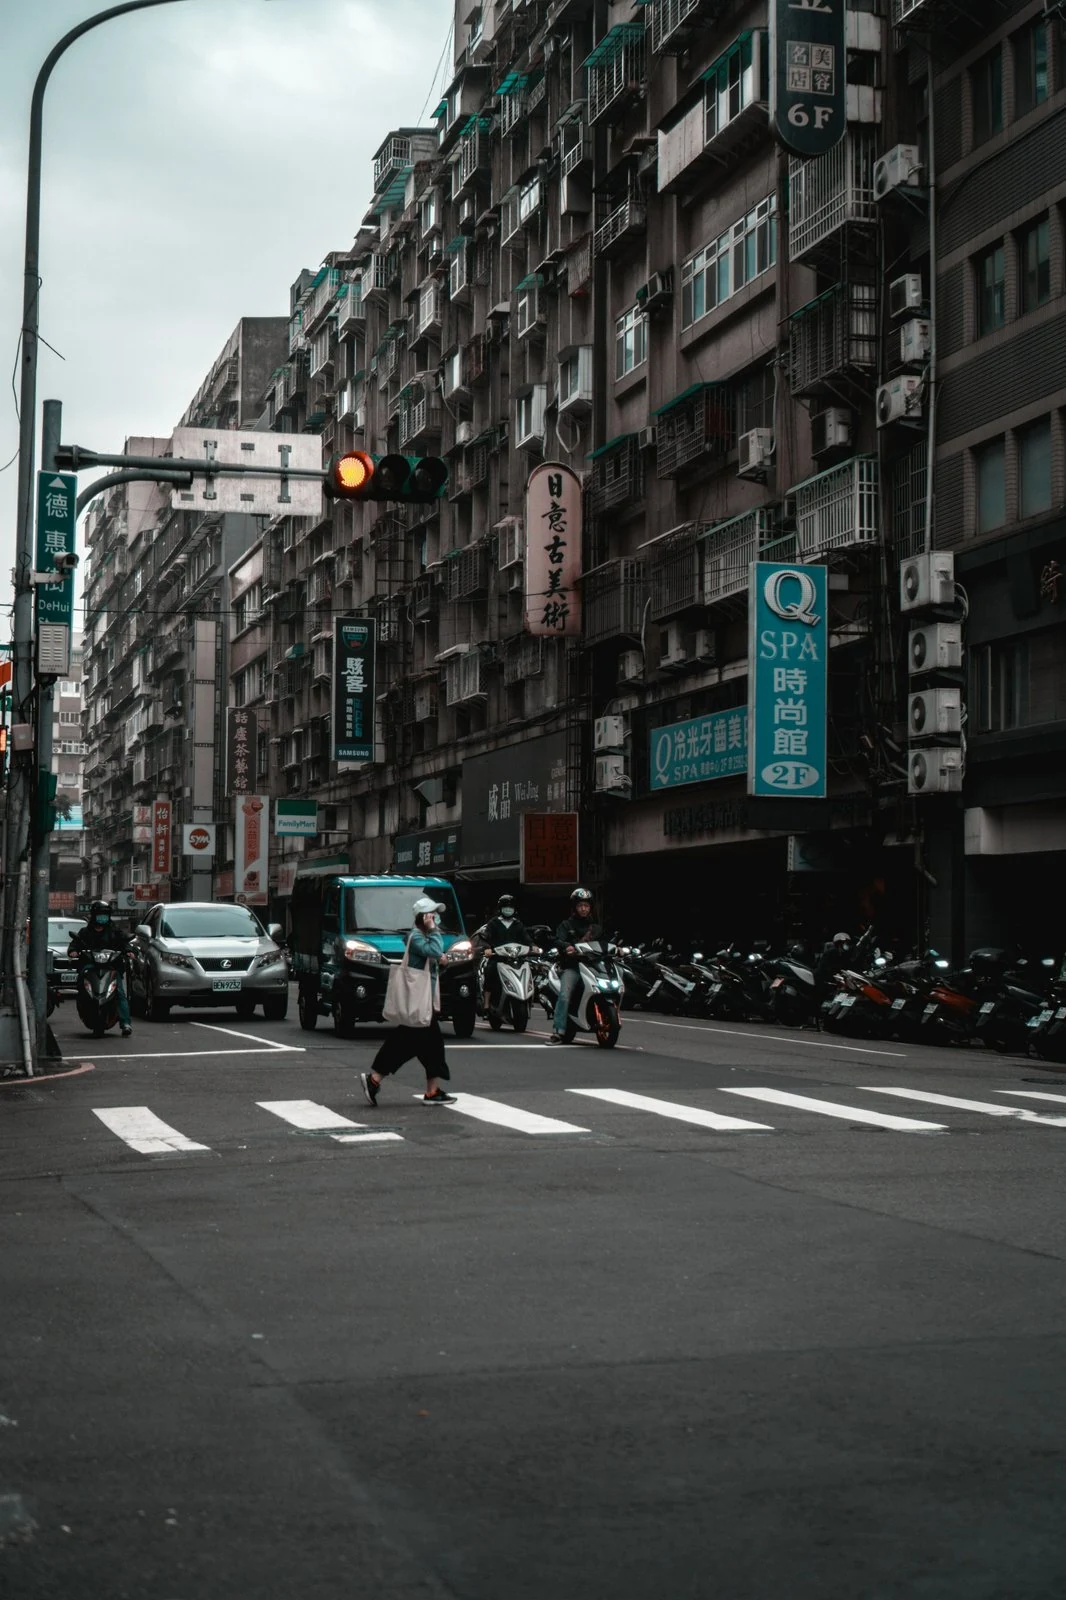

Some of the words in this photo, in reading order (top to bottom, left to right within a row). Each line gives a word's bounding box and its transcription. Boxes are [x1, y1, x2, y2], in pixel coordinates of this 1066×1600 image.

[787, 103, 834, 129] 6F
[38, 599, 70, 613] DeHui
[764, 569, 822, 626] Q
[760, 630, 820, 661] SPA
[773, 667, 808, 756] 時尚館
[338, 749, 370, 757] SAMSUNG
[655, 733, 673, 785] Q
[673, 763, 698, 781] SPA
[771, 765, 811, 786] 2F
[188, 833, 210, 845] SYM
